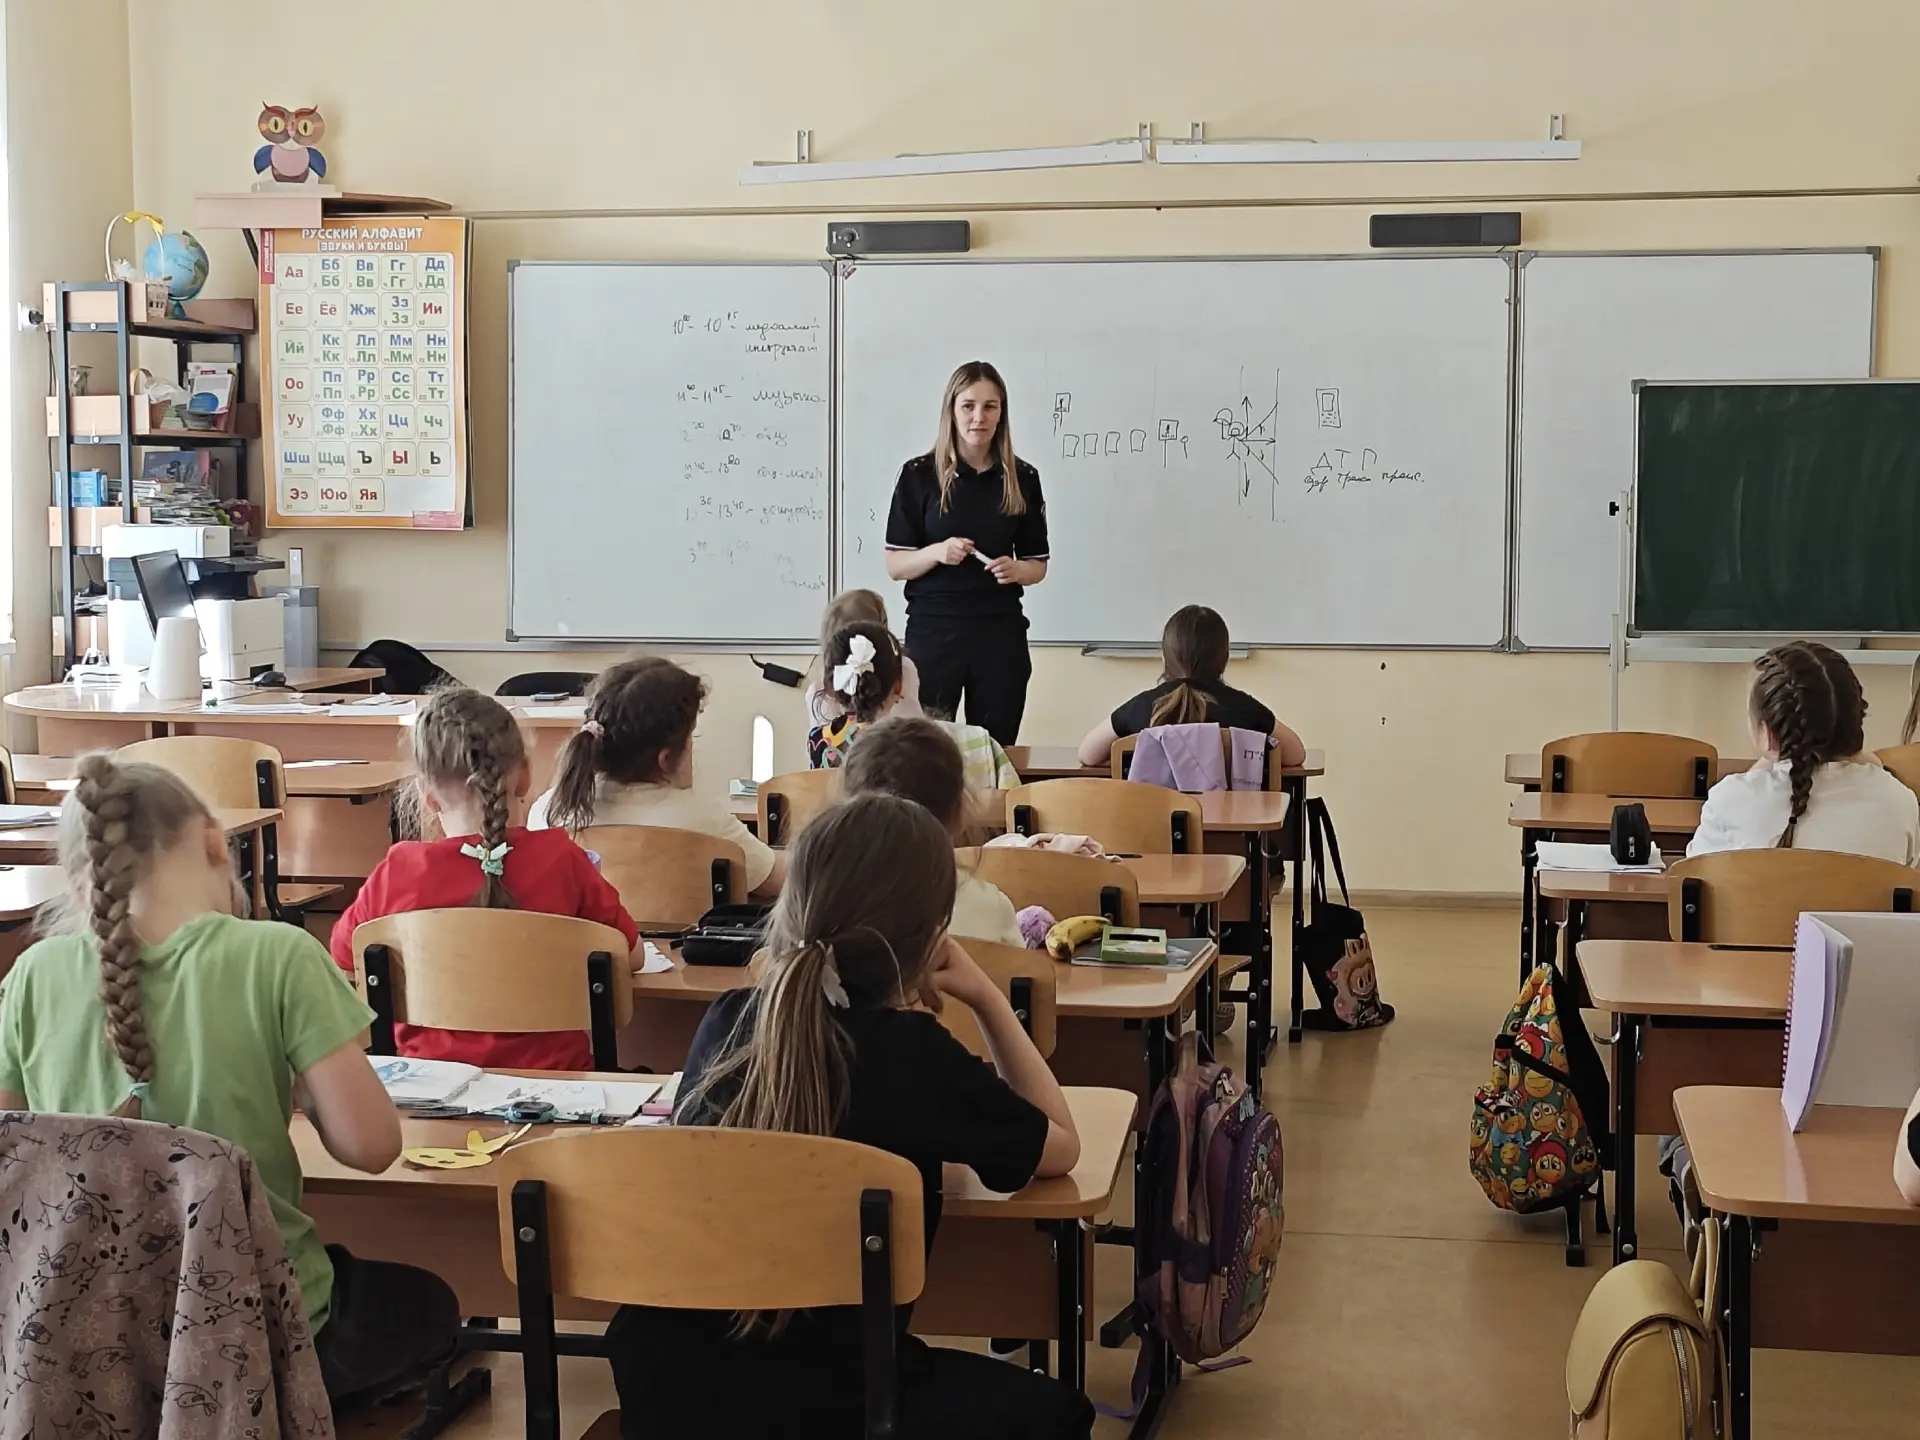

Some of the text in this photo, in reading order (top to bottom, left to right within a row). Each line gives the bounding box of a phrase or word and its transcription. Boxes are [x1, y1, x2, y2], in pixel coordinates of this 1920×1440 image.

[302, 226, 423, 240] РУССКИЙ АЛФАВИТ
[321, 258, 445, 272] Бб Вв Гг Дд
[285, 266, 304, 278] Аа
[321, 275, 340, 288] Бб
[356, 275, 374, 288] Вв
[390, 275, 405, 288] Гг
[425, 275, 445, 288] Дд
[286, 301, 376, 316] Ее Ёё Жж
[392, 296, 409, 308] Зз
[423, 302, 442, 314] Ии
[392, 312, 409, 324] Зз
[322, 334, 446, 346] Кк Лл Мм Нн
[285, 340, 304, 354] Йй
[322, 351, 340, 362] Кк
[356, 351, 376, 362] Лл
[390, 351, 413, 362] Мм
[427, 351, 446, 362] Нн
[323, 369, 444, 384] Пп Рр Сс Тт
[285, 378, 304, 390] Оо
[323, 387, 342, 399] Пп
[358, 386, 375, 400] Рр
[392, 387, 410, 399] Сс
[428, 387, 444, 399] Тт
[287, 413, 304, 428] Уу
[321, 407, 377, 421] Фф Хх
[388, 414, 443, 428] Цц Чч
[321, 424, 345, 437] Фф
[358, 424, 377, 437] Хх
[284, 450, 441, 465] Шш Щщ Ъ Ы Ь
[290, 488, 377, 500] Ээ Юю Яя
